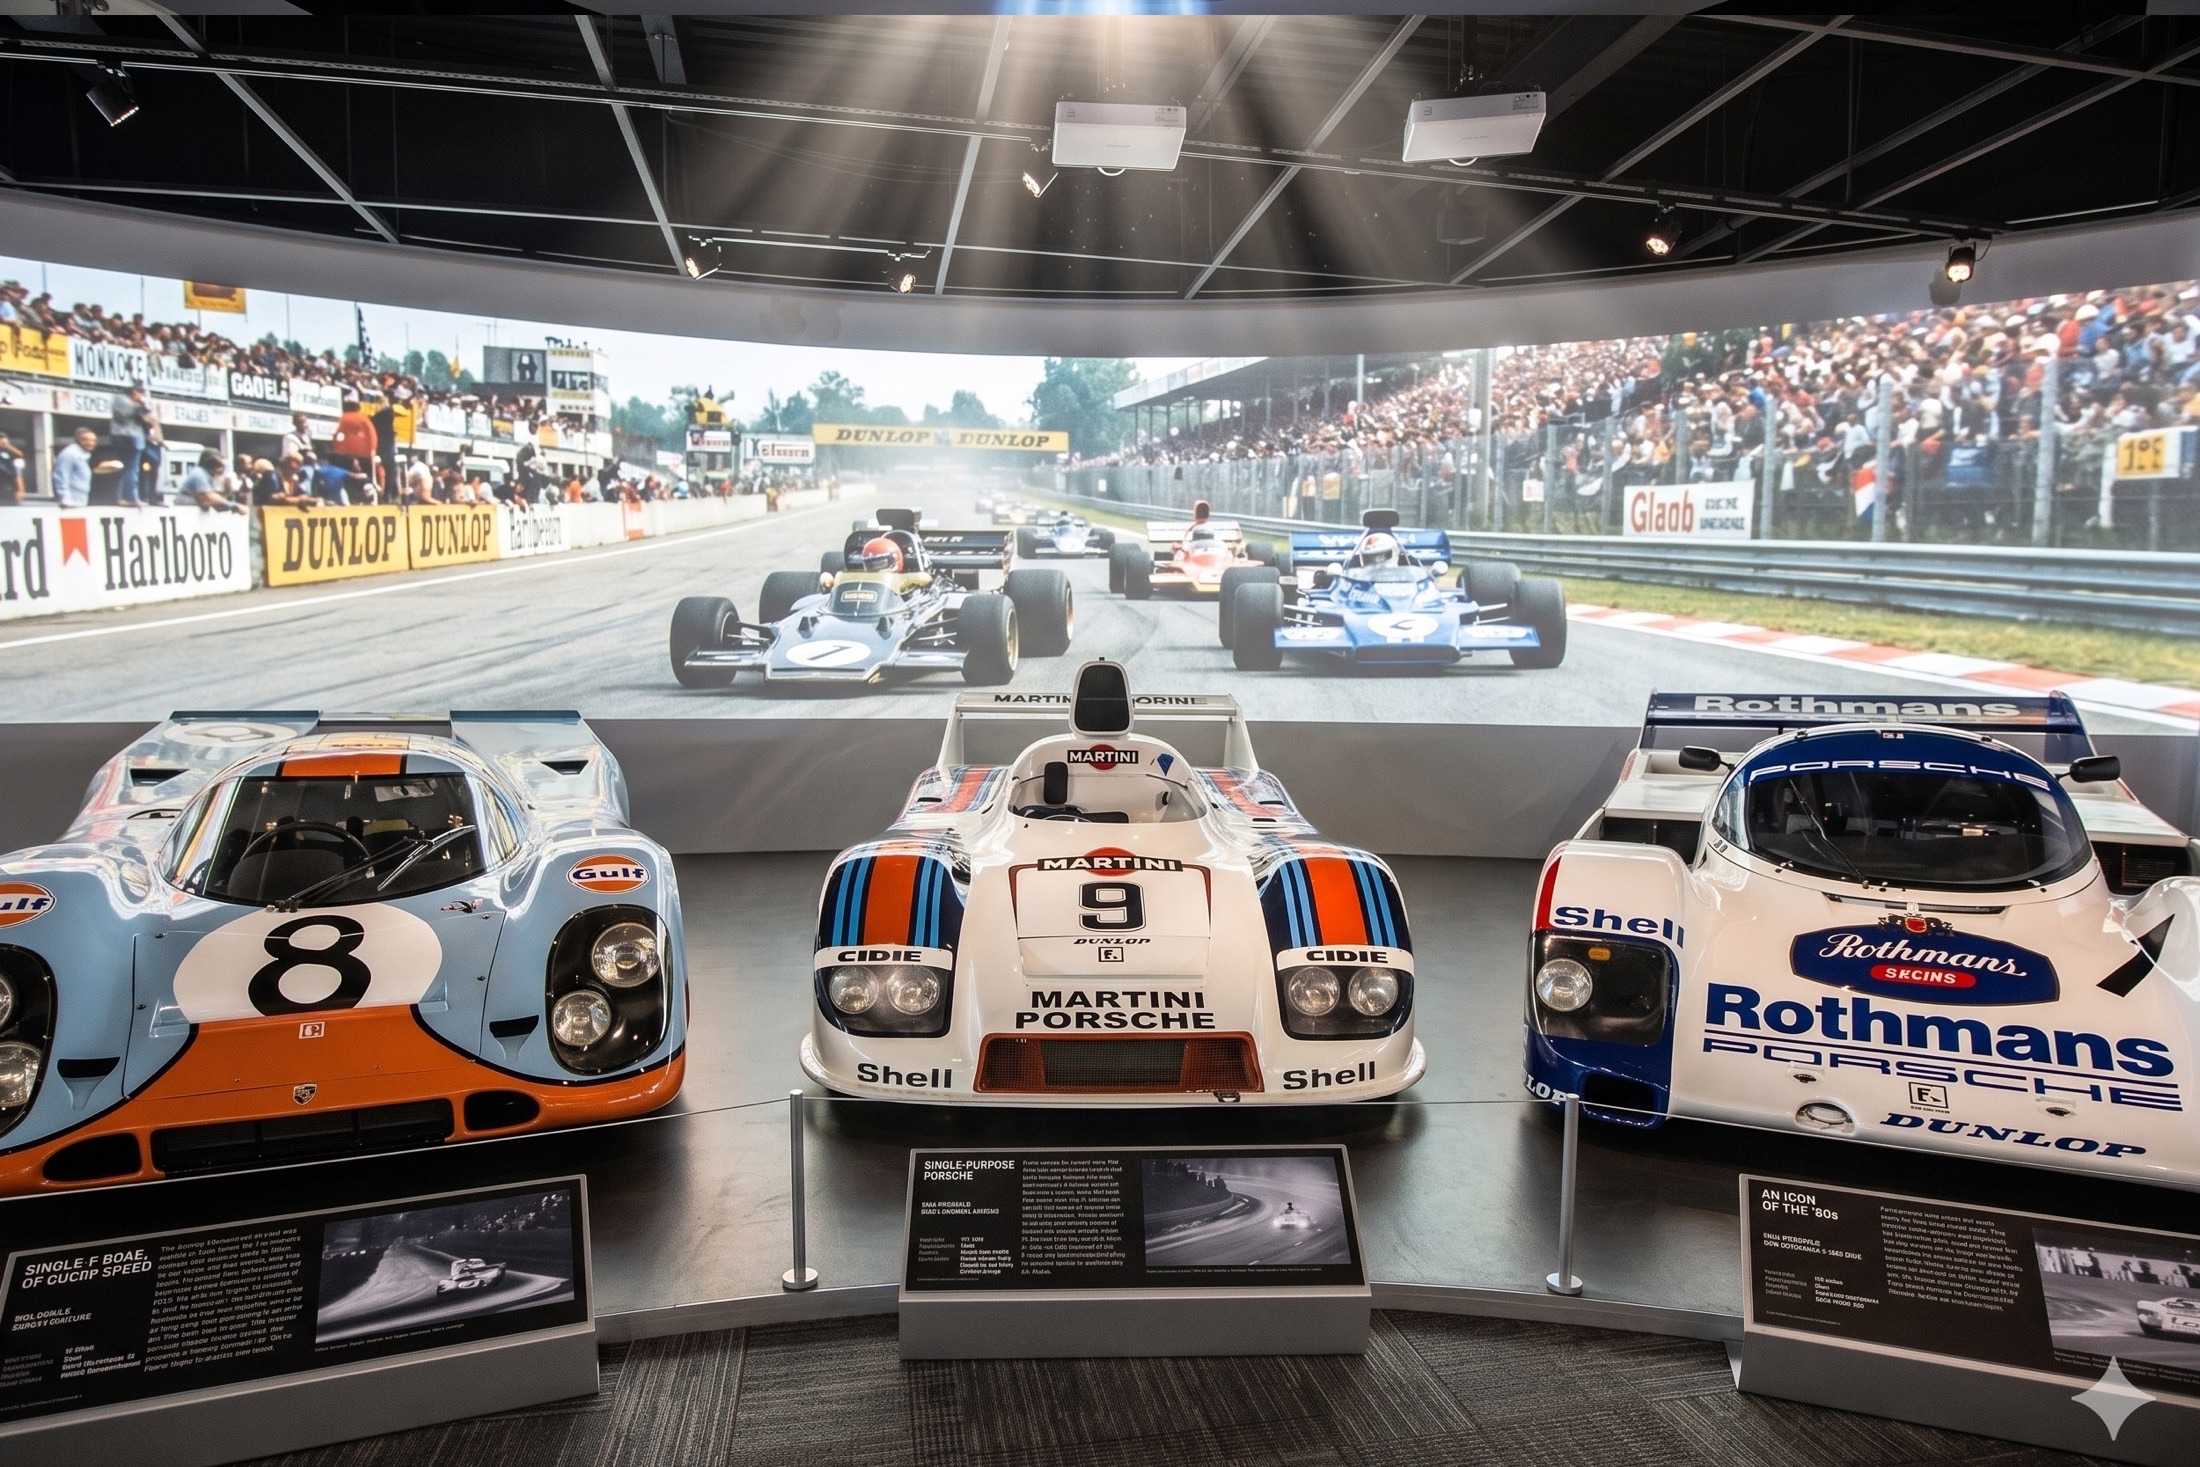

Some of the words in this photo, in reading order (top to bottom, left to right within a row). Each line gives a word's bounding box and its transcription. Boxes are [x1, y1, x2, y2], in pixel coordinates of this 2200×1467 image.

[835, 429, 931, 442] DUNLOP
[958, 432, 1050, 447] DUNLOP
[283, 516, 396, 572] DUNLOP
[420, 513, 491, 557] DUNLOP
[0, 518, 49, 600] rd
[1694, 695, 2021, 717] Rothmans
[1069, 751, 1137, 763] MARTINI
[1750, 759, 2049, 791] PORSCHE
[572, 867, 645, 880] Gulf
[1043, 857, 1177, 870] MARTINI
[1079, 881, 1146, 932] 9
[1553, 906, 1685, 949] Shell
[248, 914, 372, 1016] 8
[837, 950, 922, 962] CIDIE
[1306, 950, 1389, 963] CIDIE
[1818, 932, 2028, 977] Rothmans
[1031, 990, 1205, 1008] MARTINI
[1015, 1011, 1216, 1029] PORSCHE
[1704, 981, 2176, 1078] Rothmans
[857, 1062, 953, 1089] Shell
[1282, 1061, 1376, 1090] Shell
[1523, 1070, 1567, 1105] LOP
[1702, 1037, 2184, 1112] PORSCHE
[1879, 1112, 2147, 1158] DUNLOP
[923, 1171, 974, 1180] PORSCHE
[924, 1160, 1015, 1170] SINGLE-PURPOSE
[1761, 1189, 1780, 1201] AN
[1784, 1191, 1817, 1206] ICON
[1762, 1201, 1780, 1212] OF
[1782, 1203, 1809, 1216] THE
[1811, 1206, 1839, 1220] '80s
[21, 1276, 44, 1289] OF
[101, 1261, 153, 1278] SPEED
